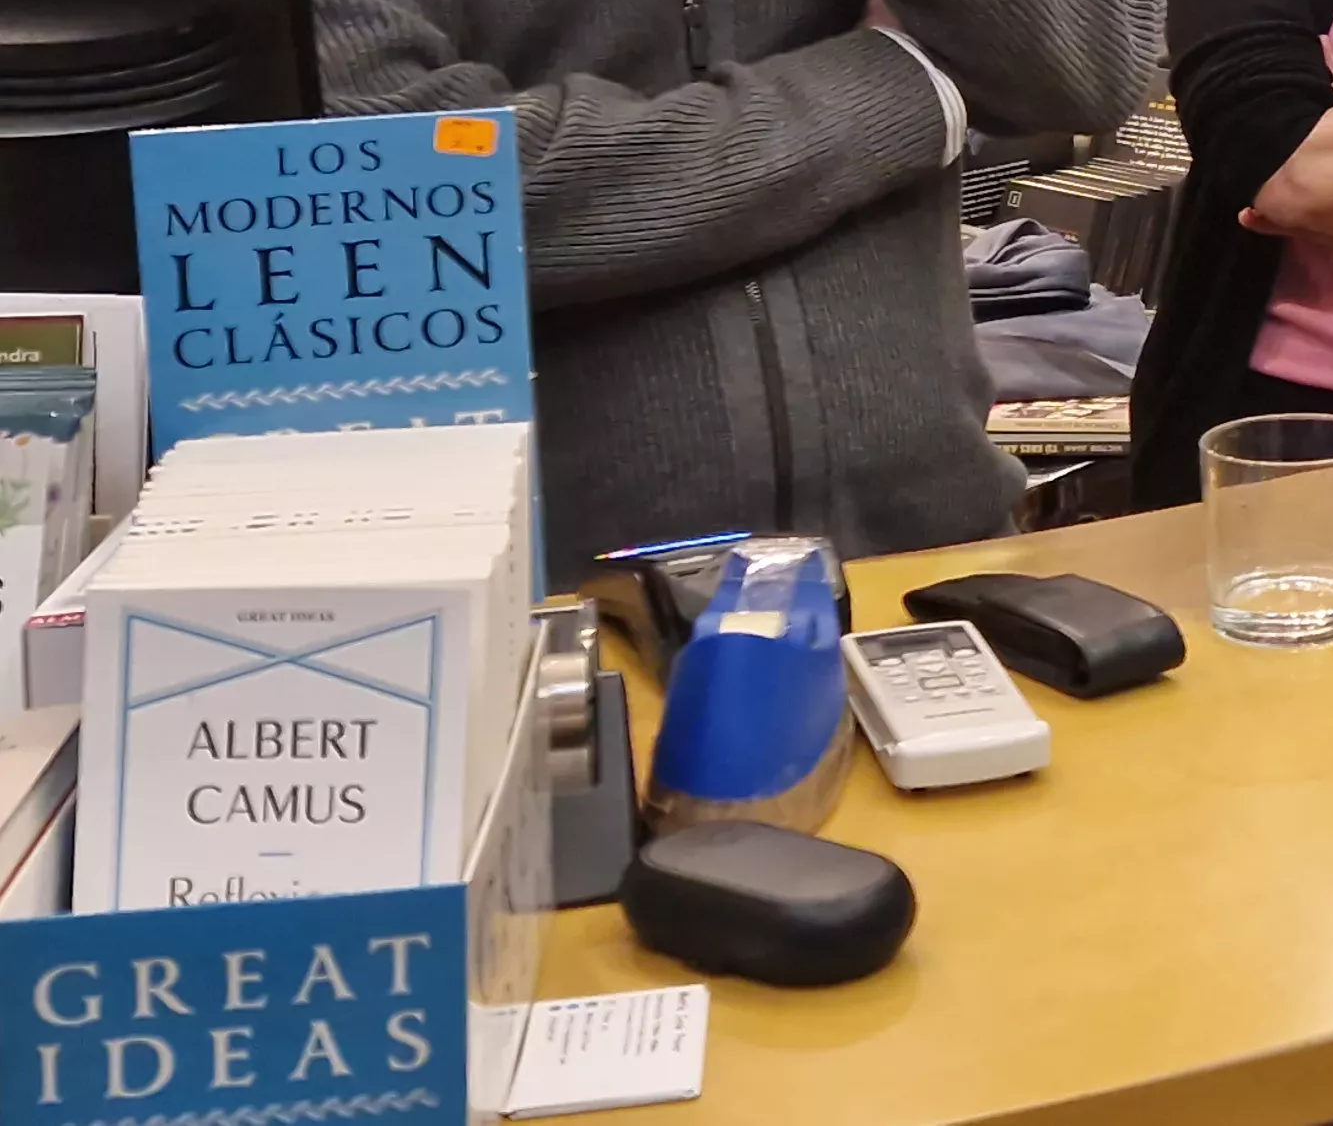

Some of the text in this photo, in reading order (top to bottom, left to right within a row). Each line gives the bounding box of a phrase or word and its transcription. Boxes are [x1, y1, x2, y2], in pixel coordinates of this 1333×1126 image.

[276, 138, 383, 177] LOS
[165, 181, 496, 237] MODERNOS
[171, 231, 496, 312] LEEN
[173, 303, 505, 370] CLÁSICOS
[237, 610, 335, 624] GREAT IDEAS
[187, 719, 378, 762] ALBERT
[187, 783, 368, 825] CAMUS
[32, 932, 433, 1026] GREAT
[37, 1010, 433, 1104] IDEAS
